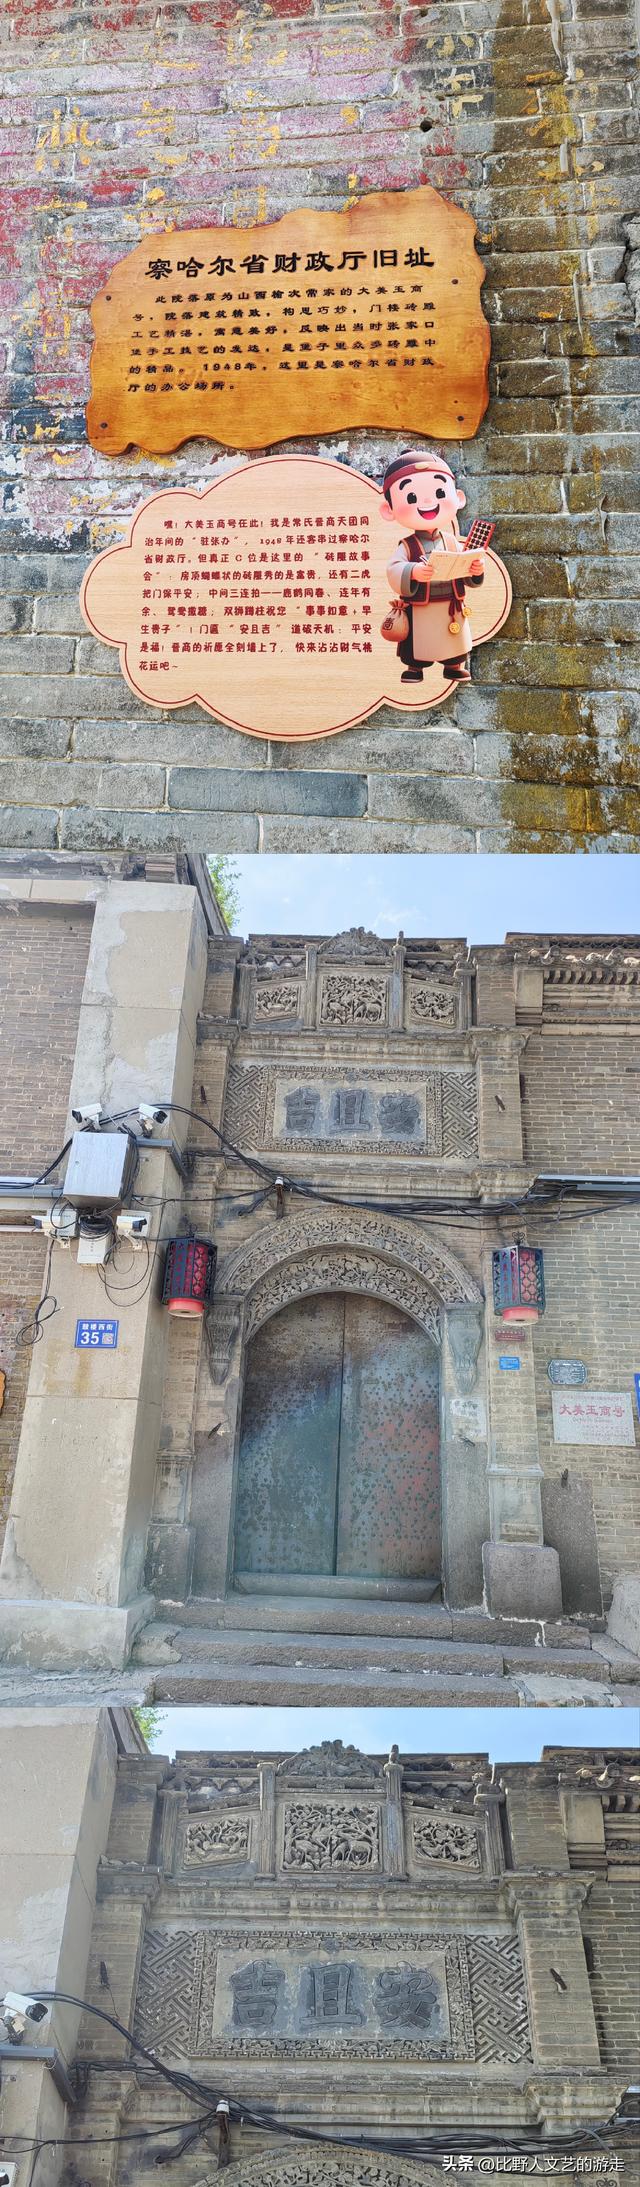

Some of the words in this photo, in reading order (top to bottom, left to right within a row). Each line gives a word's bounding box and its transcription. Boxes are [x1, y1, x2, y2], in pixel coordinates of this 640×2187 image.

[144, 246, 435, 281] 察哈尔省财政厅旧址
[155, 284, 424, 304] 此院落原为山西榆次常家的大美玉商
[127, 380, 237, 393] 厅的办公场所。
[80, 1331, 100, 1345] 35
